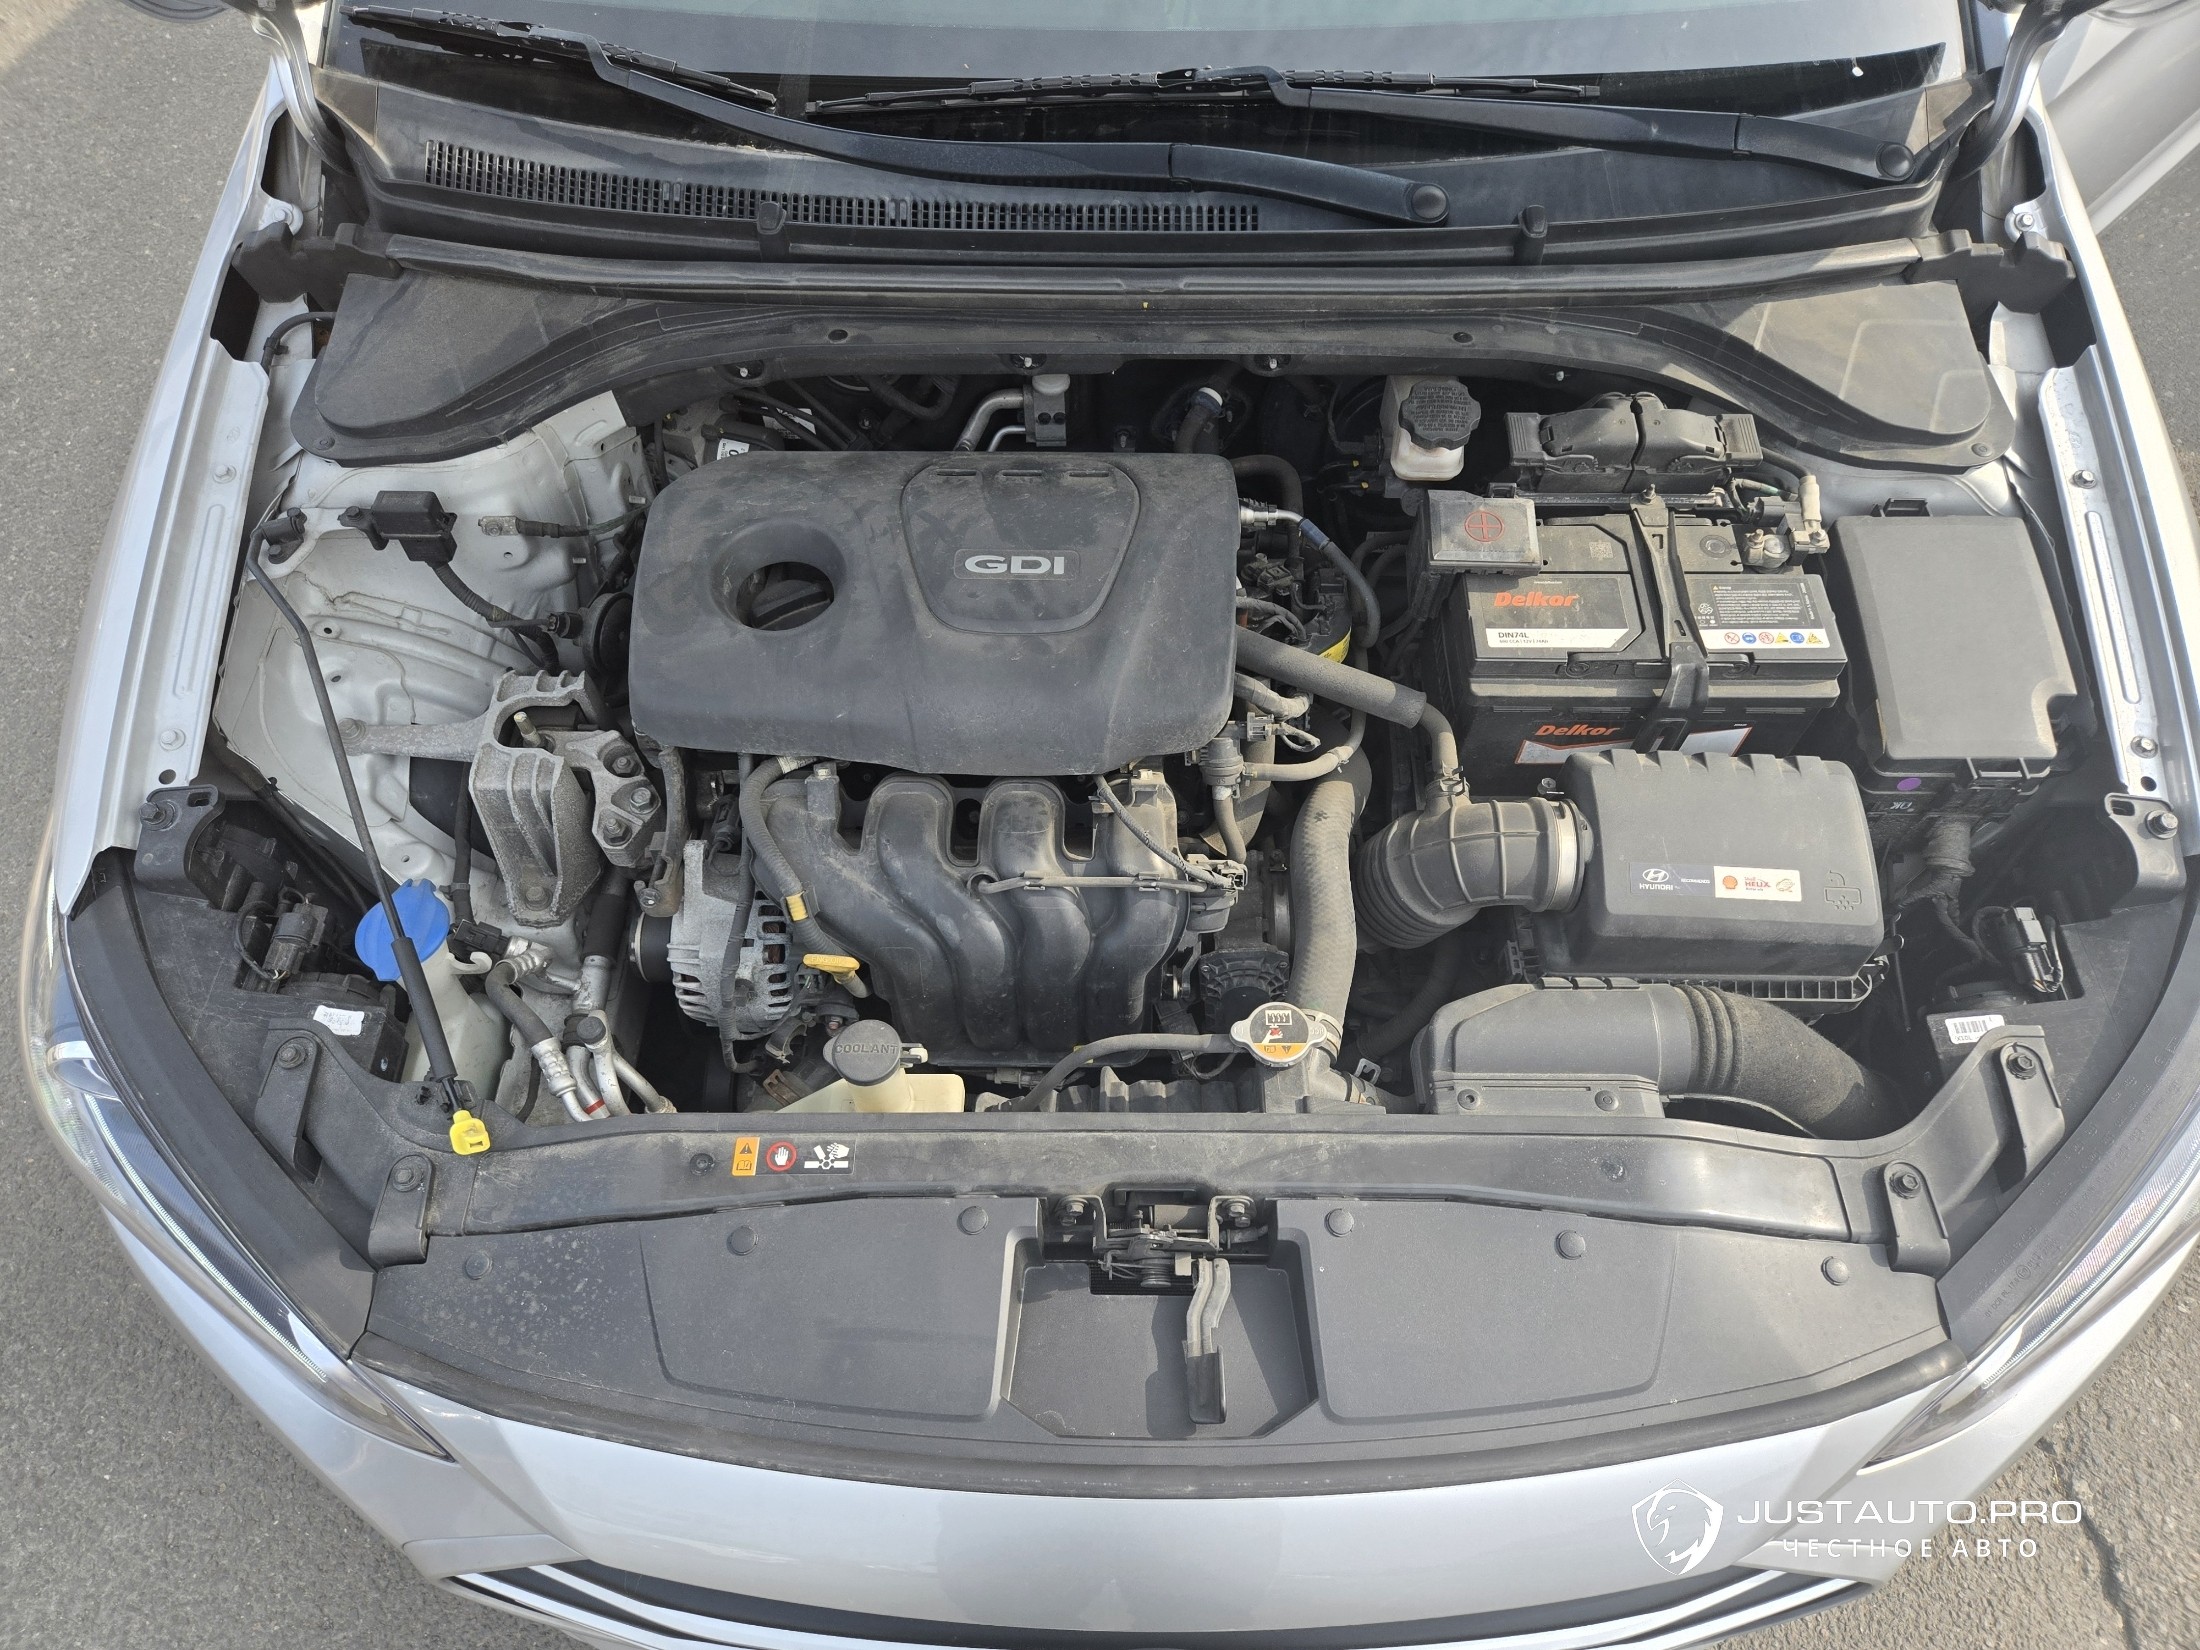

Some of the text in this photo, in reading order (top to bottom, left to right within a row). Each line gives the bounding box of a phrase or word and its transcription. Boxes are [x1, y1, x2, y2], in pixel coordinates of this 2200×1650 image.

[964, 554, 1065, 575] GDI
[1494, 591, 1578, 607] Delkor
[1534, 724, 1620, 736] Delkor
[835, 1043, 898, 1055] COOLANT
